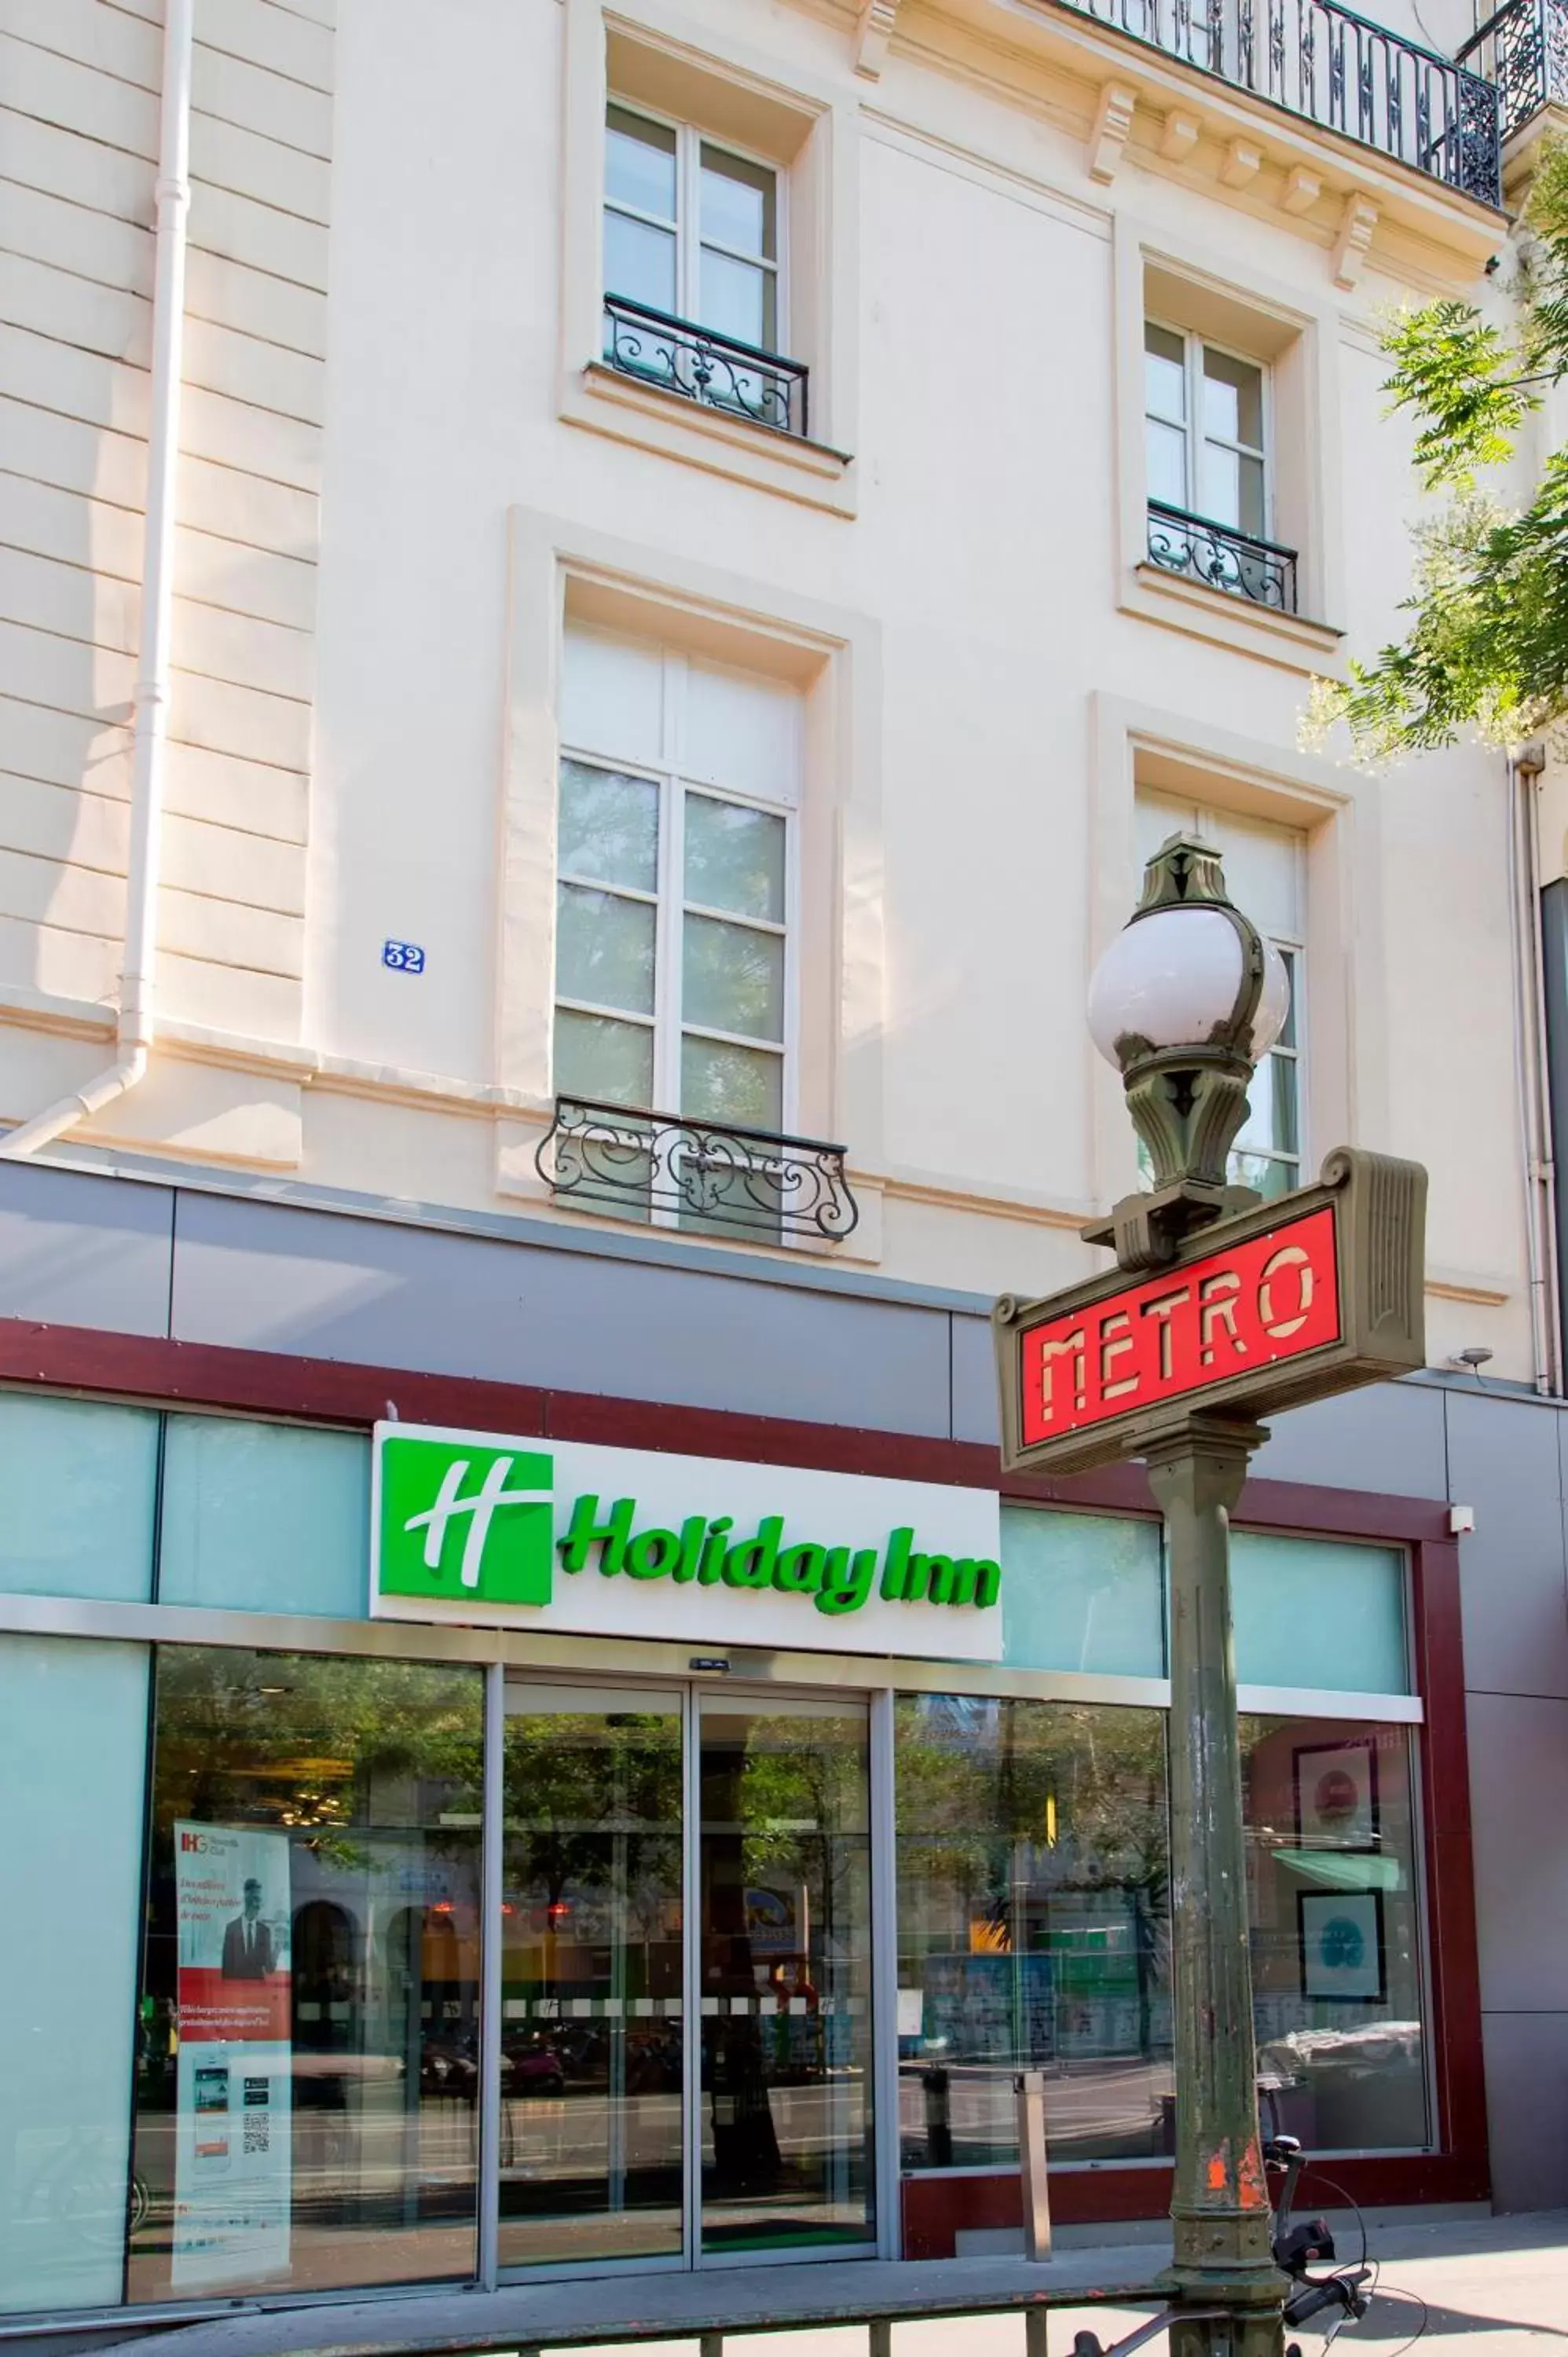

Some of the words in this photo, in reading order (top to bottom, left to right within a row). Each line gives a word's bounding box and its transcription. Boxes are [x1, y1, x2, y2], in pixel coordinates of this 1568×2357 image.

[387, 943, 421, 971] 32
[1042, 1245, 1313, 1421] METRO
[557, 1494, 877, 1615] Holiday
[879, 1527, 1001, 1609] Inn
[181, 1832, 207, 1854] IHG
